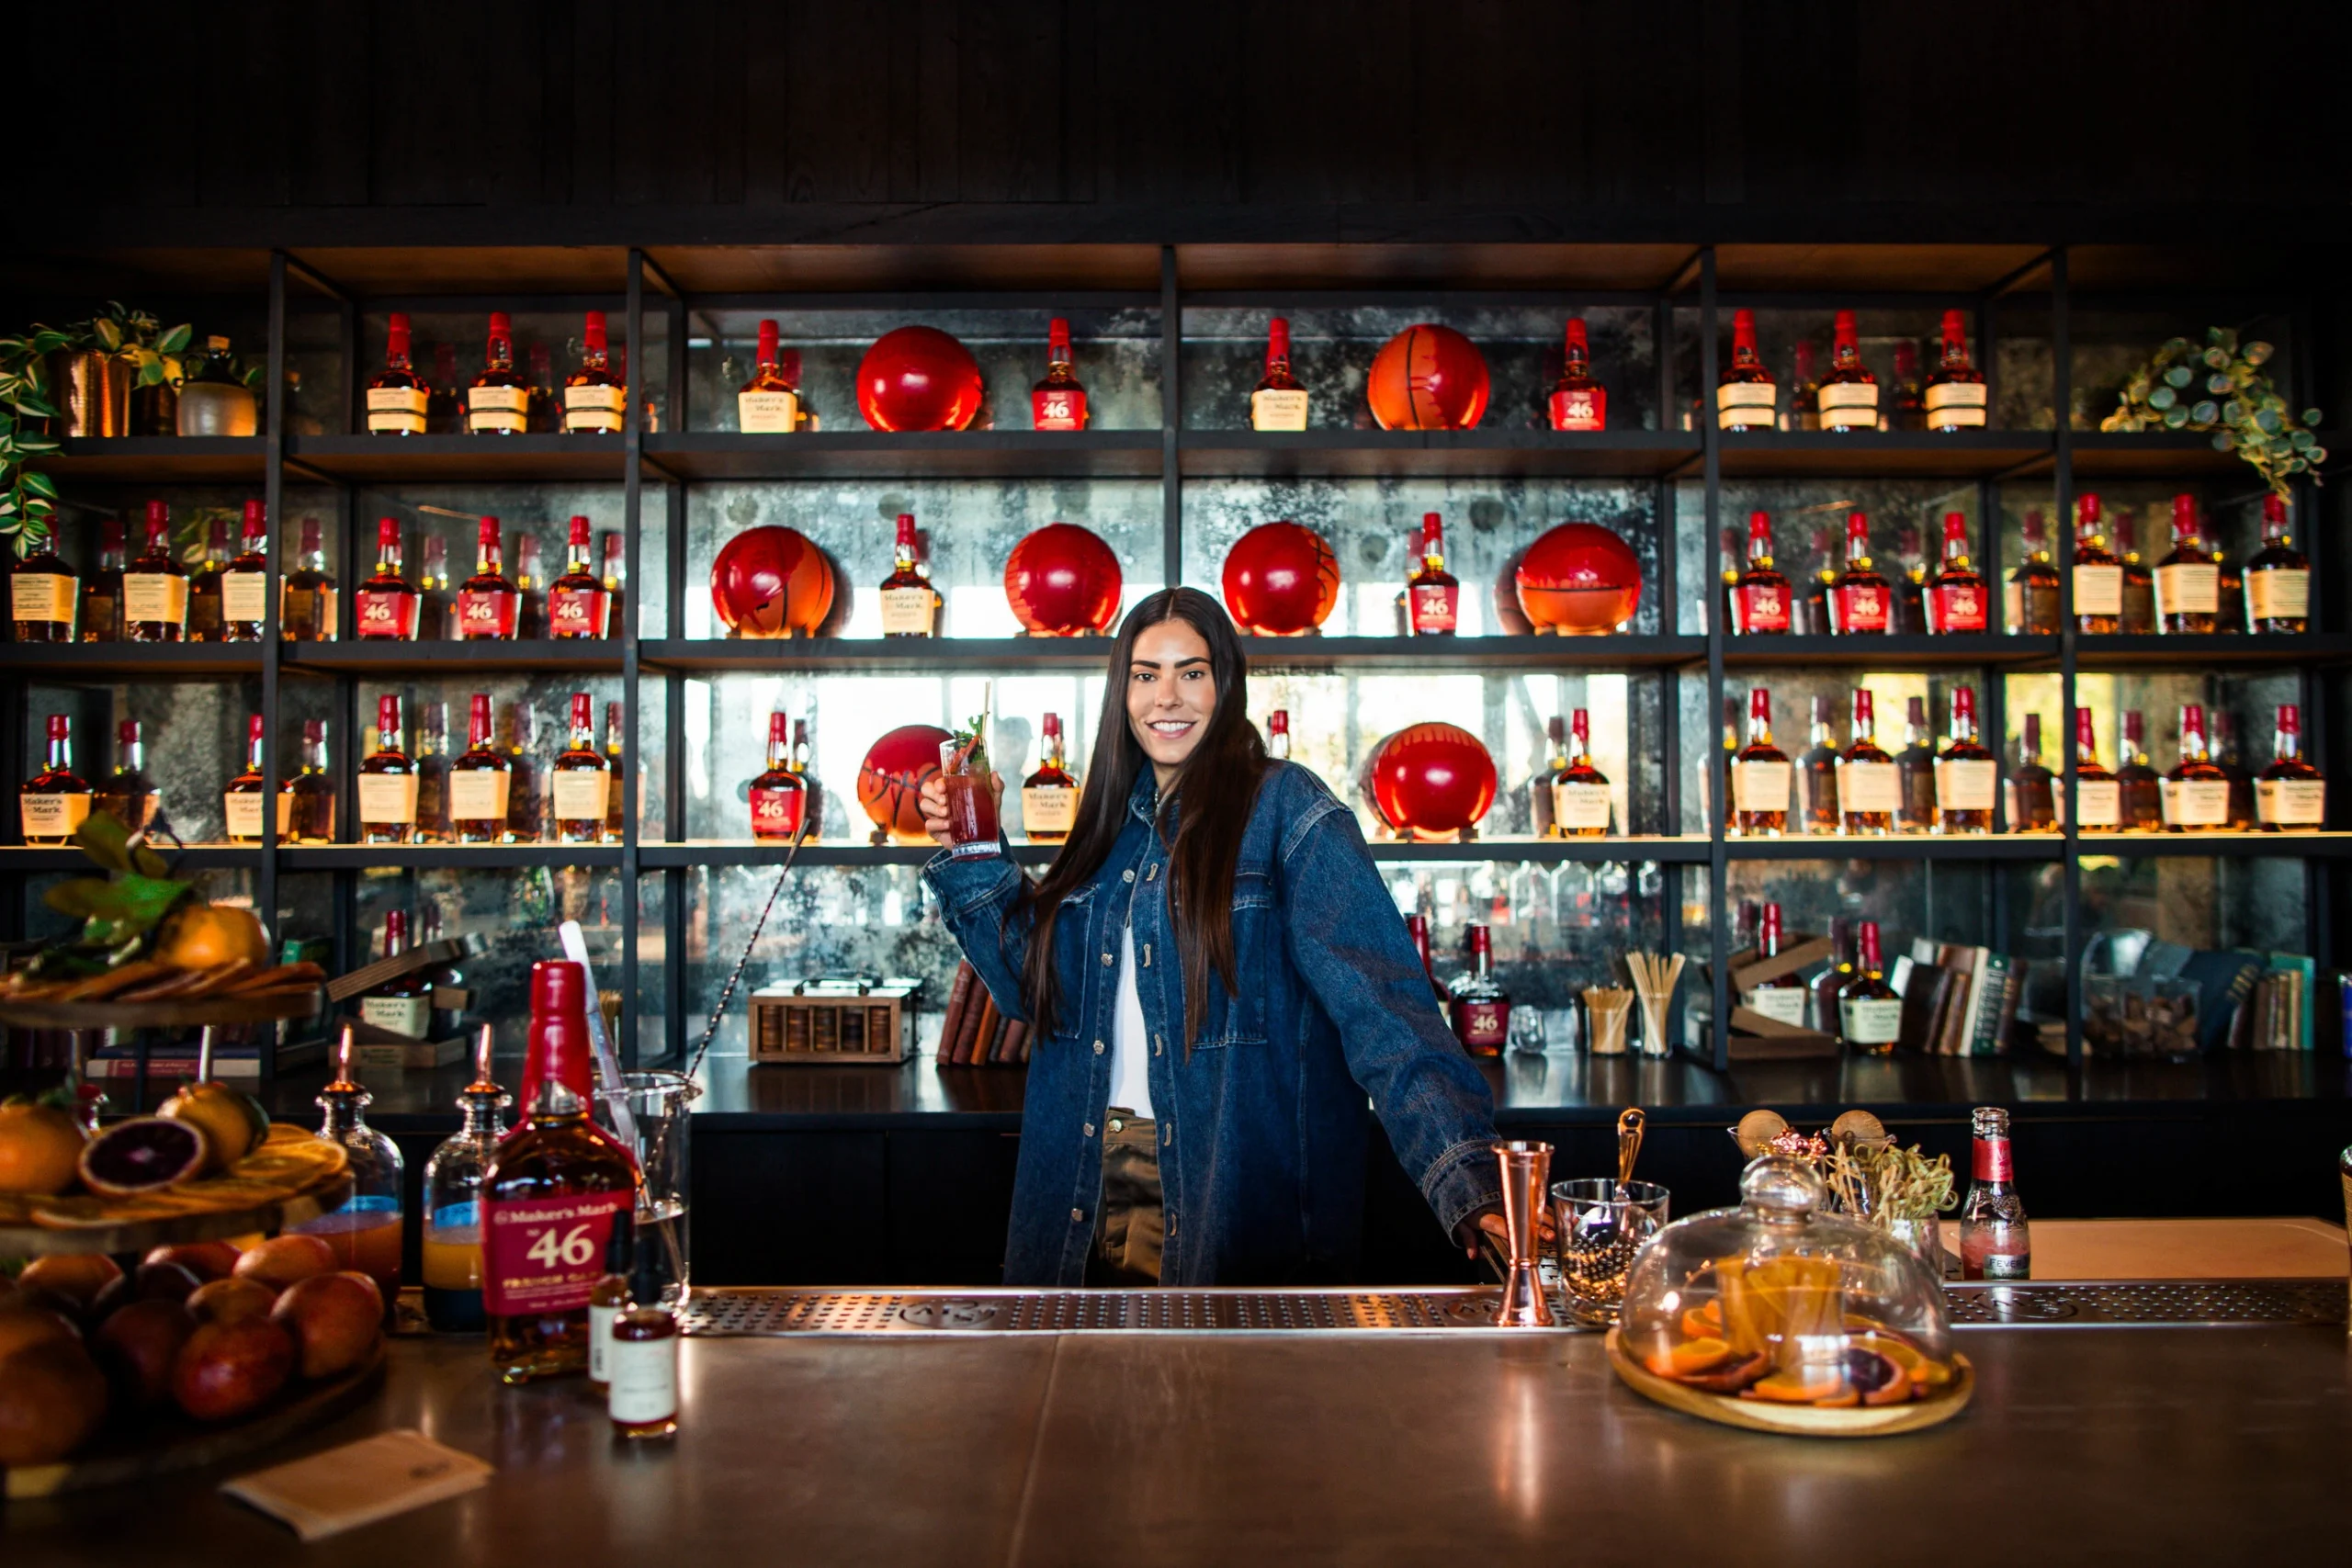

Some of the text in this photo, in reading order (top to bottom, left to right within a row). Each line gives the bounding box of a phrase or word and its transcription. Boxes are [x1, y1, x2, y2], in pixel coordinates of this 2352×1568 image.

[1042, 400, 1070, 419] 46
[1566, 400, 1595, 419] 46
[364, 602, 390, 620] 46
[466, 602, 492, 620] 46
[557, 602, 583, 620] 46
[1421, 597, 1449, 615] 46
[1754, 597, 1781, 616] 46
[1853, 597, 1882, 616] 46
[1951, 597, 1979, 616] 46
[757, 799, 785, 818] 46
[1473, 1013, 1499, 1031] 46
[509, 1201, 618, 1224] Maker's Mark
[526, 1224, 595, 1269] 46
